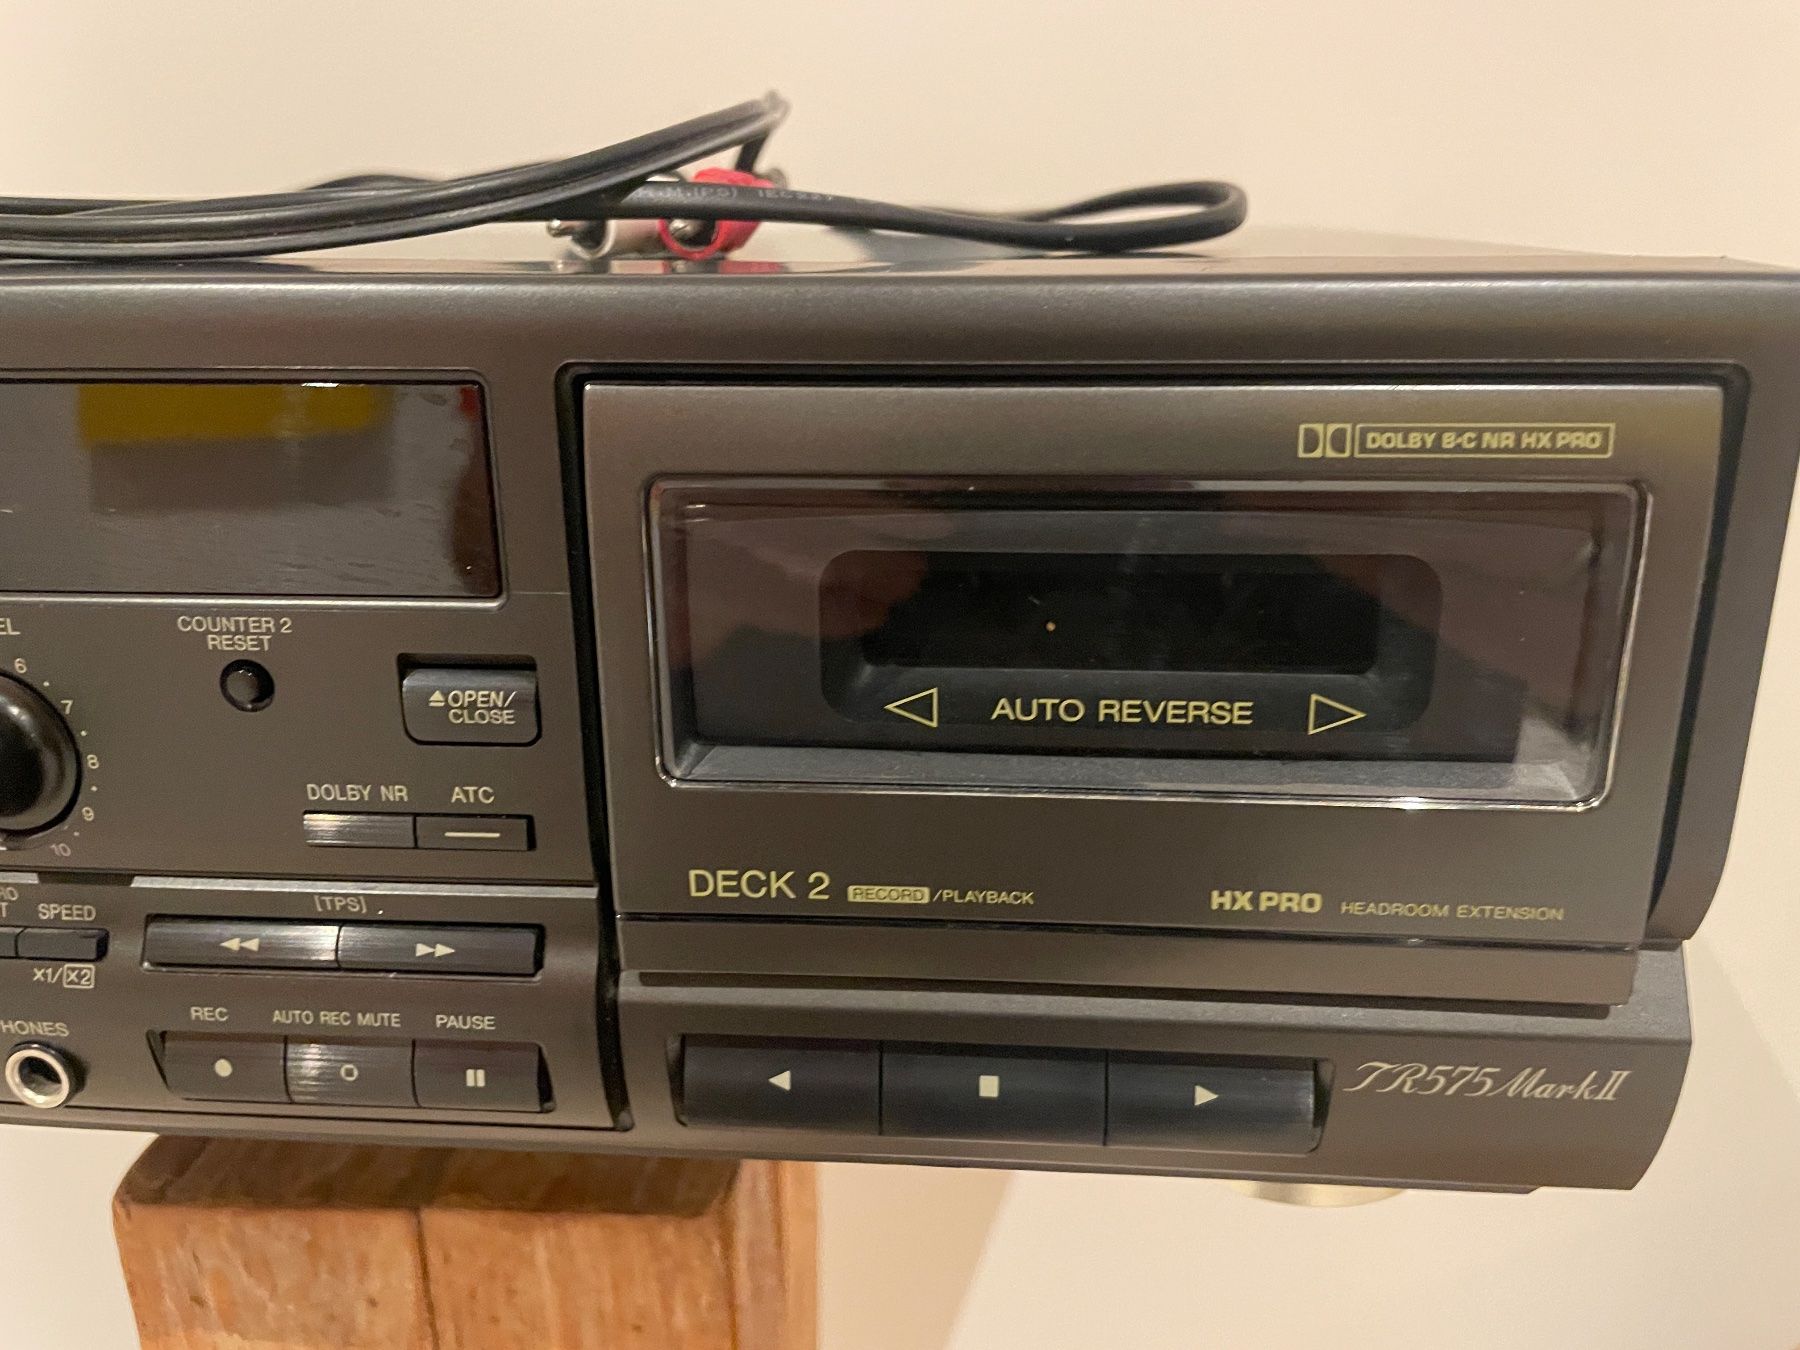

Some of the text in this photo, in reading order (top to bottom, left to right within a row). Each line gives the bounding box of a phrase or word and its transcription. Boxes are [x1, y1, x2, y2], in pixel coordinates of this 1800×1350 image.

[1365, 431, 1437, 449] DOLBY
[1481, 431, 1516, 449] NR
[1520, 432, 1554, 449] HX
[1555, 432, 1602, 449] PRO
[177, 616, 293, 633] COUNTER 2
[207, 635, 272, 651] RESET
[14, 658, 27, 674] 6
[60, 700, 74, 715] 7
[991, 697, 1254, 725] AUTO REVERSE
[449, 709, 516, 725] CLOSE
[86, 754, 99, 769] 8
[306, 784, 409, 802] DOLBY NR
[450, 786, 495, 804] ATC
[81, 806, 95, 822] 9
[51, 842, 72, 858] 10
[688, 869, 796, 899] DECK
[807, 871, 832, 900] 2
[850, 886, 927, 903] RECORD
[38, 903, 97, 921] SPEED
[1209, 890, 1565, 921] HX PRO HEADROOM EXTENSION
[190, 1007, 229, 1022] REC
[272, 1010, 401, 1028] AUTO REC MUTE
[435, 1014, 496, 1031] PAUSE
[1342, 1061, 1501, 1098] TR575
